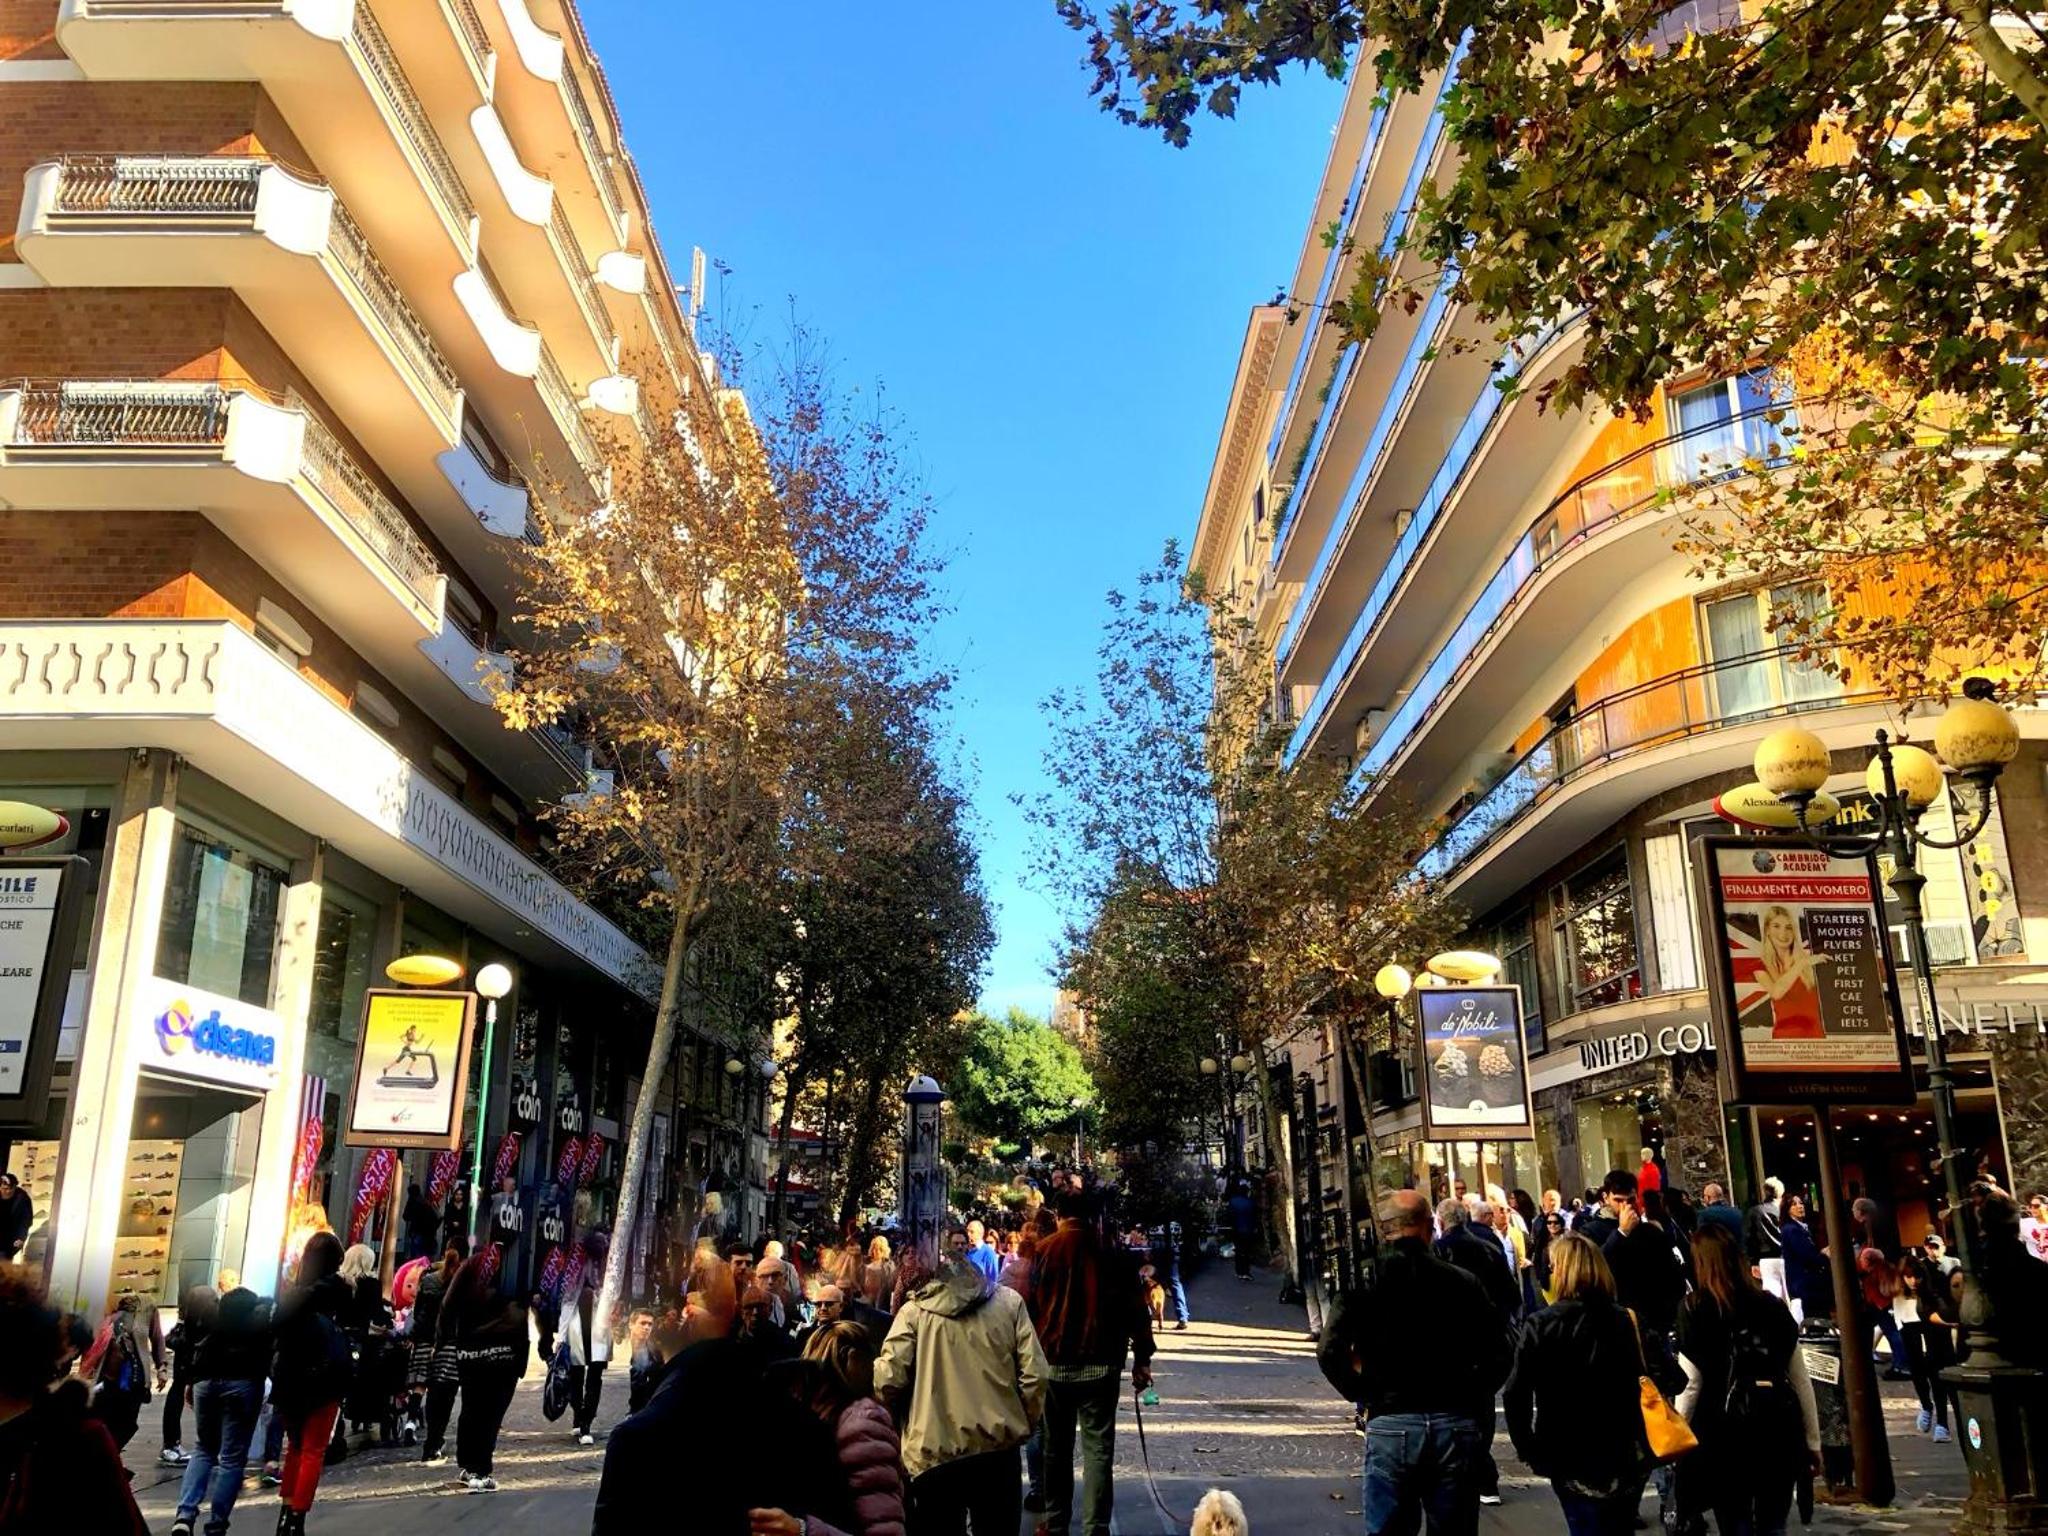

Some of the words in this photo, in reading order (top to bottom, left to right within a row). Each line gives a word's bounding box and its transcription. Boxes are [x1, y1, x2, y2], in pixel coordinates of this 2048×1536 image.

[1776, 853, 1831, 863] CAMBRIDGE
[1782, 862, 1828, 872] ACADEMY
[1725, 884, 1798, 896] FINALMENTE
[1799, 884, 1813, 895] AL
[1815, 883, 1868, 896] VOMERO
[1812, 915, 1866, 924] STARTERS
[1817, 927, 1863, 937] MOVERS
[1823, 940, 1862, 950] FLYERS
[1834, 953, 1855, 962] KET
[1837, 966, 1857, 975] PET
[1834, 979, 1864, 989] FIRST
[1840, 992, 1862, 1002] CAE
[1842, 1005, 1864, 1015] CPE
[1841, 1018, 1869, 1028] IELTS
[1578, 1032, 1651, 1070] UNITED
[517, 1079, 542, 1122] coin
[561, 1093, 583, 1133] coin
[499, 1191, 524, 1233] coin
[543, 1203, 565, 1243] coin
